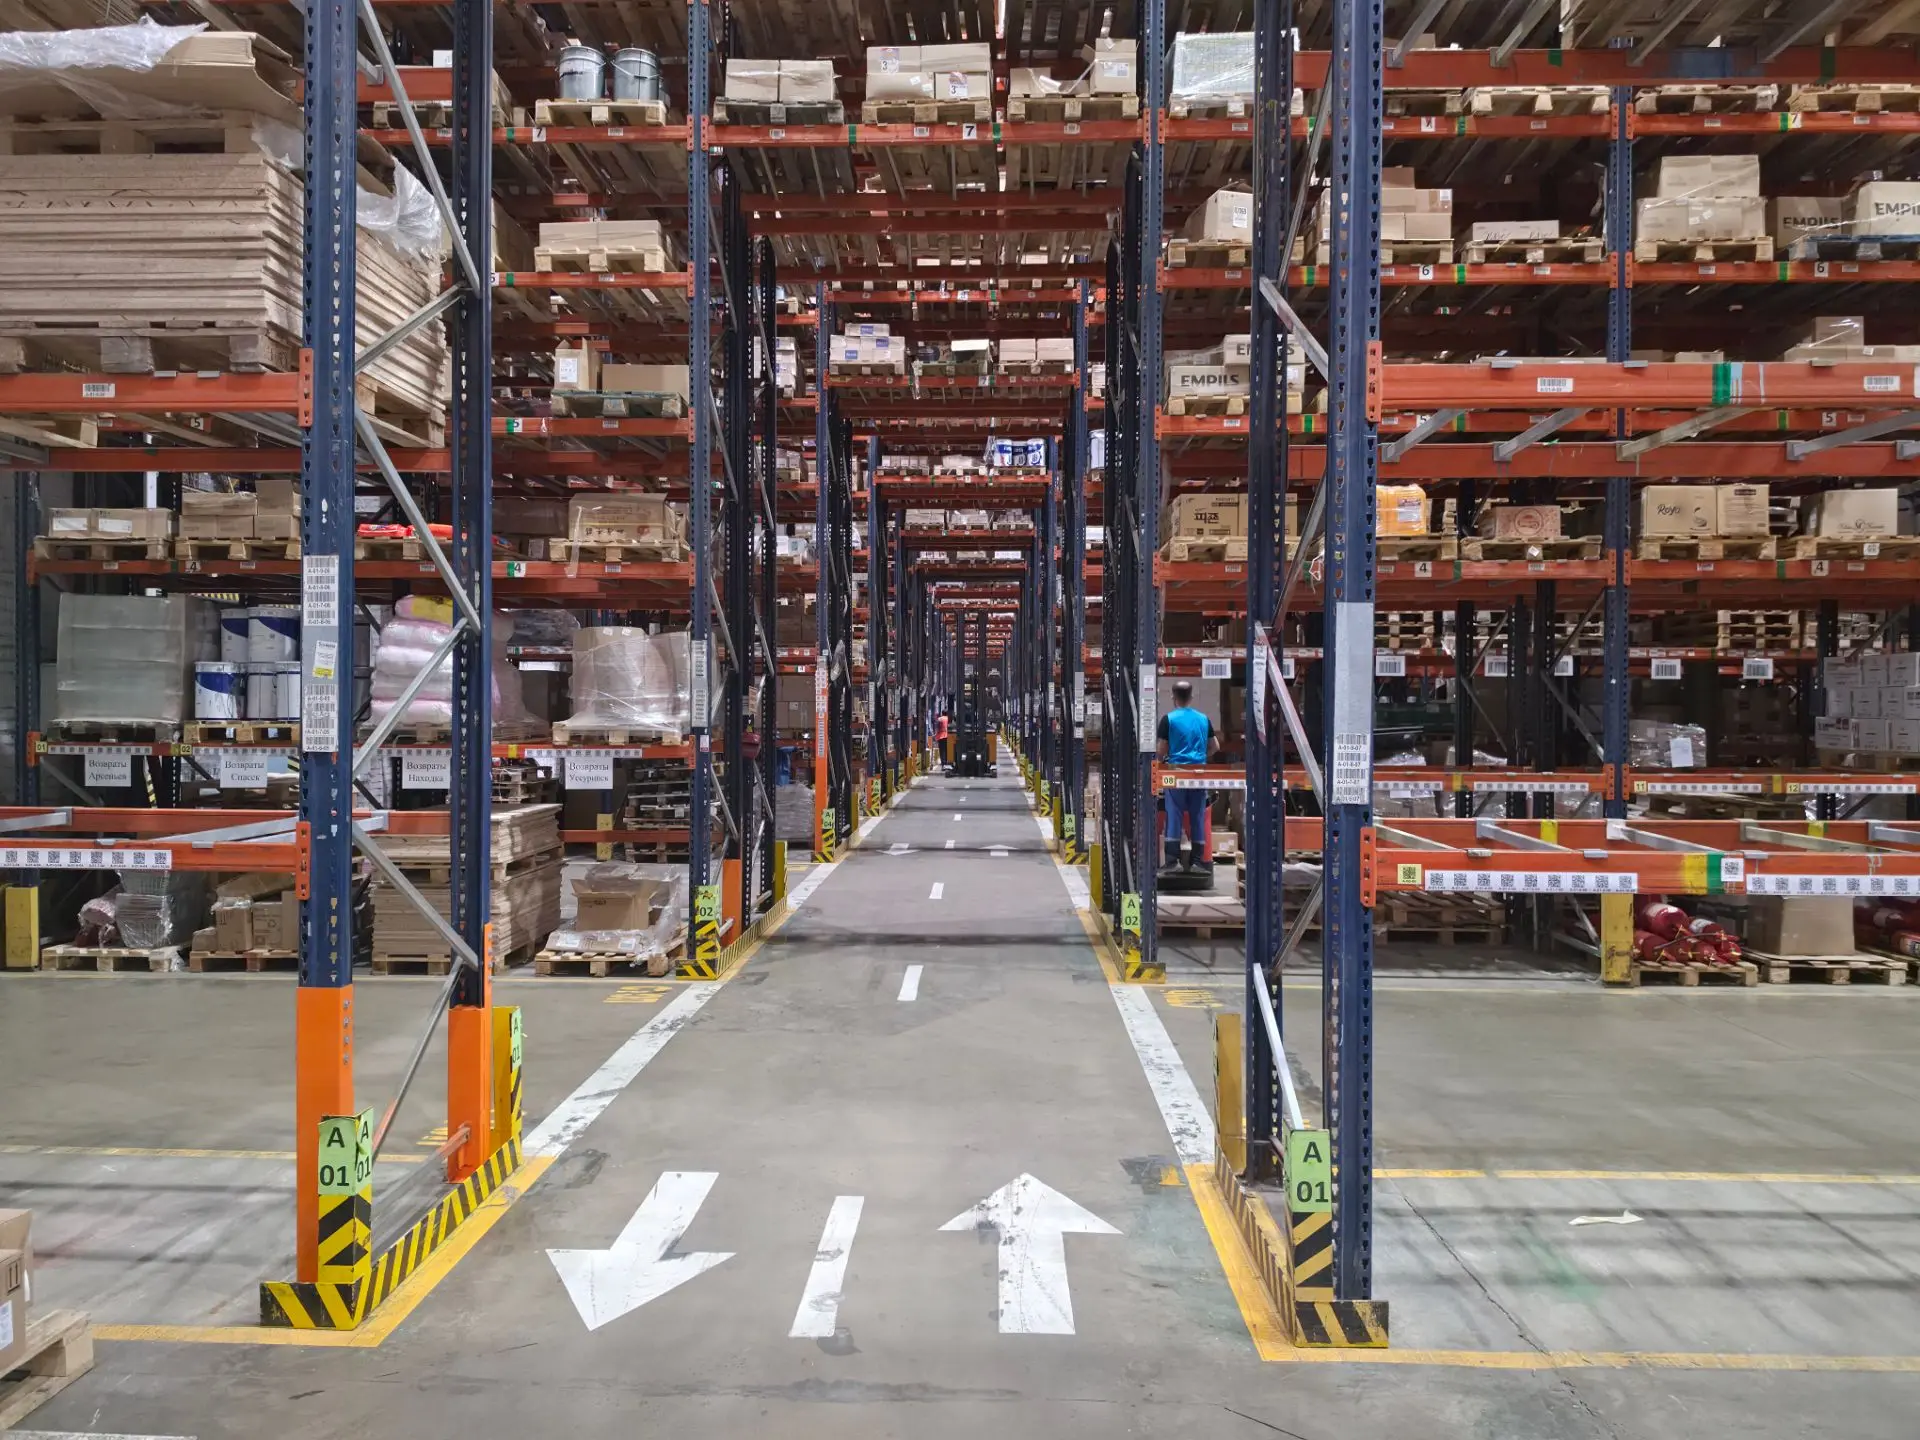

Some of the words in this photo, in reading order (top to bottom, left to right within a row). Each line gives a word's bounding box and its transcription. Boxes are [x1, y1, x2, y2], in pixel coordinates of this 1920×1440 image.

[965, 125, 974, 137] 7
[1422, 264, 1430, 276] 6
[1816, 262, 1825, 273] 6
[1180, 373, 1240, 388] EMPILS
[1825, 411, 1833, 423] 5
[194, 419, 201, 429] 5
[189, 561, 198, 572] 4
[513, 562, 522, 573] 4
[1419, 562, 1428, 574] 4
[1816, 561, 1824, 573] 4
[36, 743, 45, 751] 01
[181, 745, 191, 753] 02
[88, 760, 127, 770] Возвраты
[225, 761, 264, 771] Возвраты
[406, 761, 447, 772] Возвраты
[569, 762, 609, 772] Возвраты
[88, 772, 127, 782] Арсеньев
[408, 774, 444, 783] Находка
[569, 773, 609, 783] Уссурийск
[1164, 776, 1174, 785] 08
[1636, 783, 1645, 791] 11
[1788, 784, 1799, 793] 12
[1127, 899, 1136, 909] A
[700, 906, 713, 917] 02
[1125, 916, 1138, 926] 02
[360, 1120, 369, 1143] A
[326, 1126, 346, 1149] A
[1302, 1141, 1323, 1164] A
[356, 1155, 371, 1183] 01
[319, 1164, 350, 1187] 01
[1296, 1180, 1329, 1203] 01
